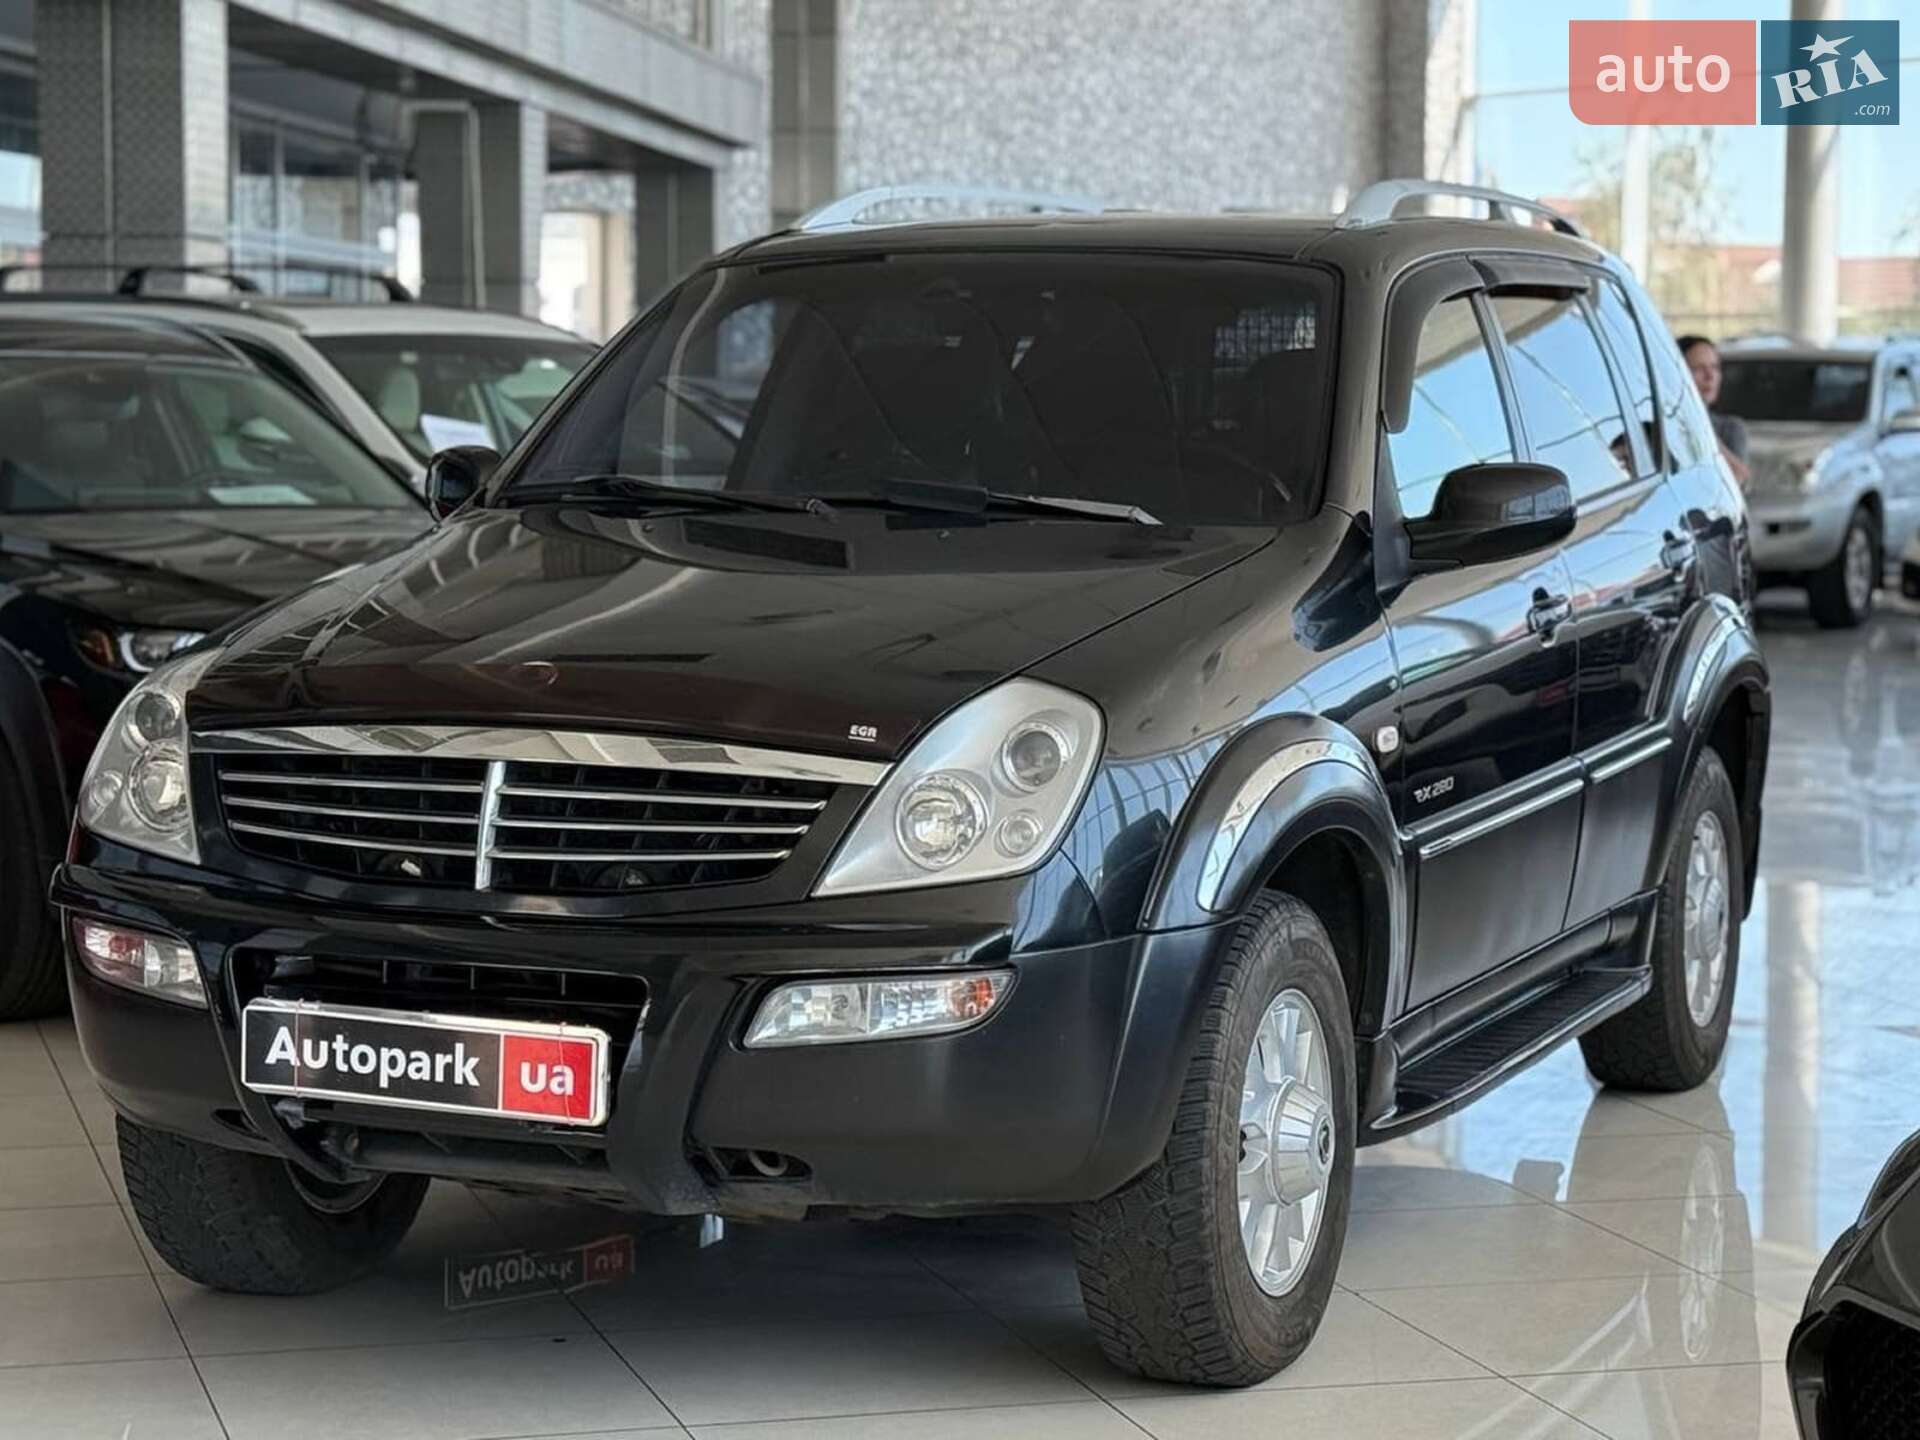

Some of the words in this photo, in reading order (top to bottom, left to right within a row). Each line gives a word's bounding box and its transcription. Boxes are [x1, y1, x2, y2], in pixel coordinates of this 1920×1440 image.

[849, 724, 878, 738] EGR
[264, 1026, 481, 1089] Autopark
[519, 1060, 575, 1097] ua
